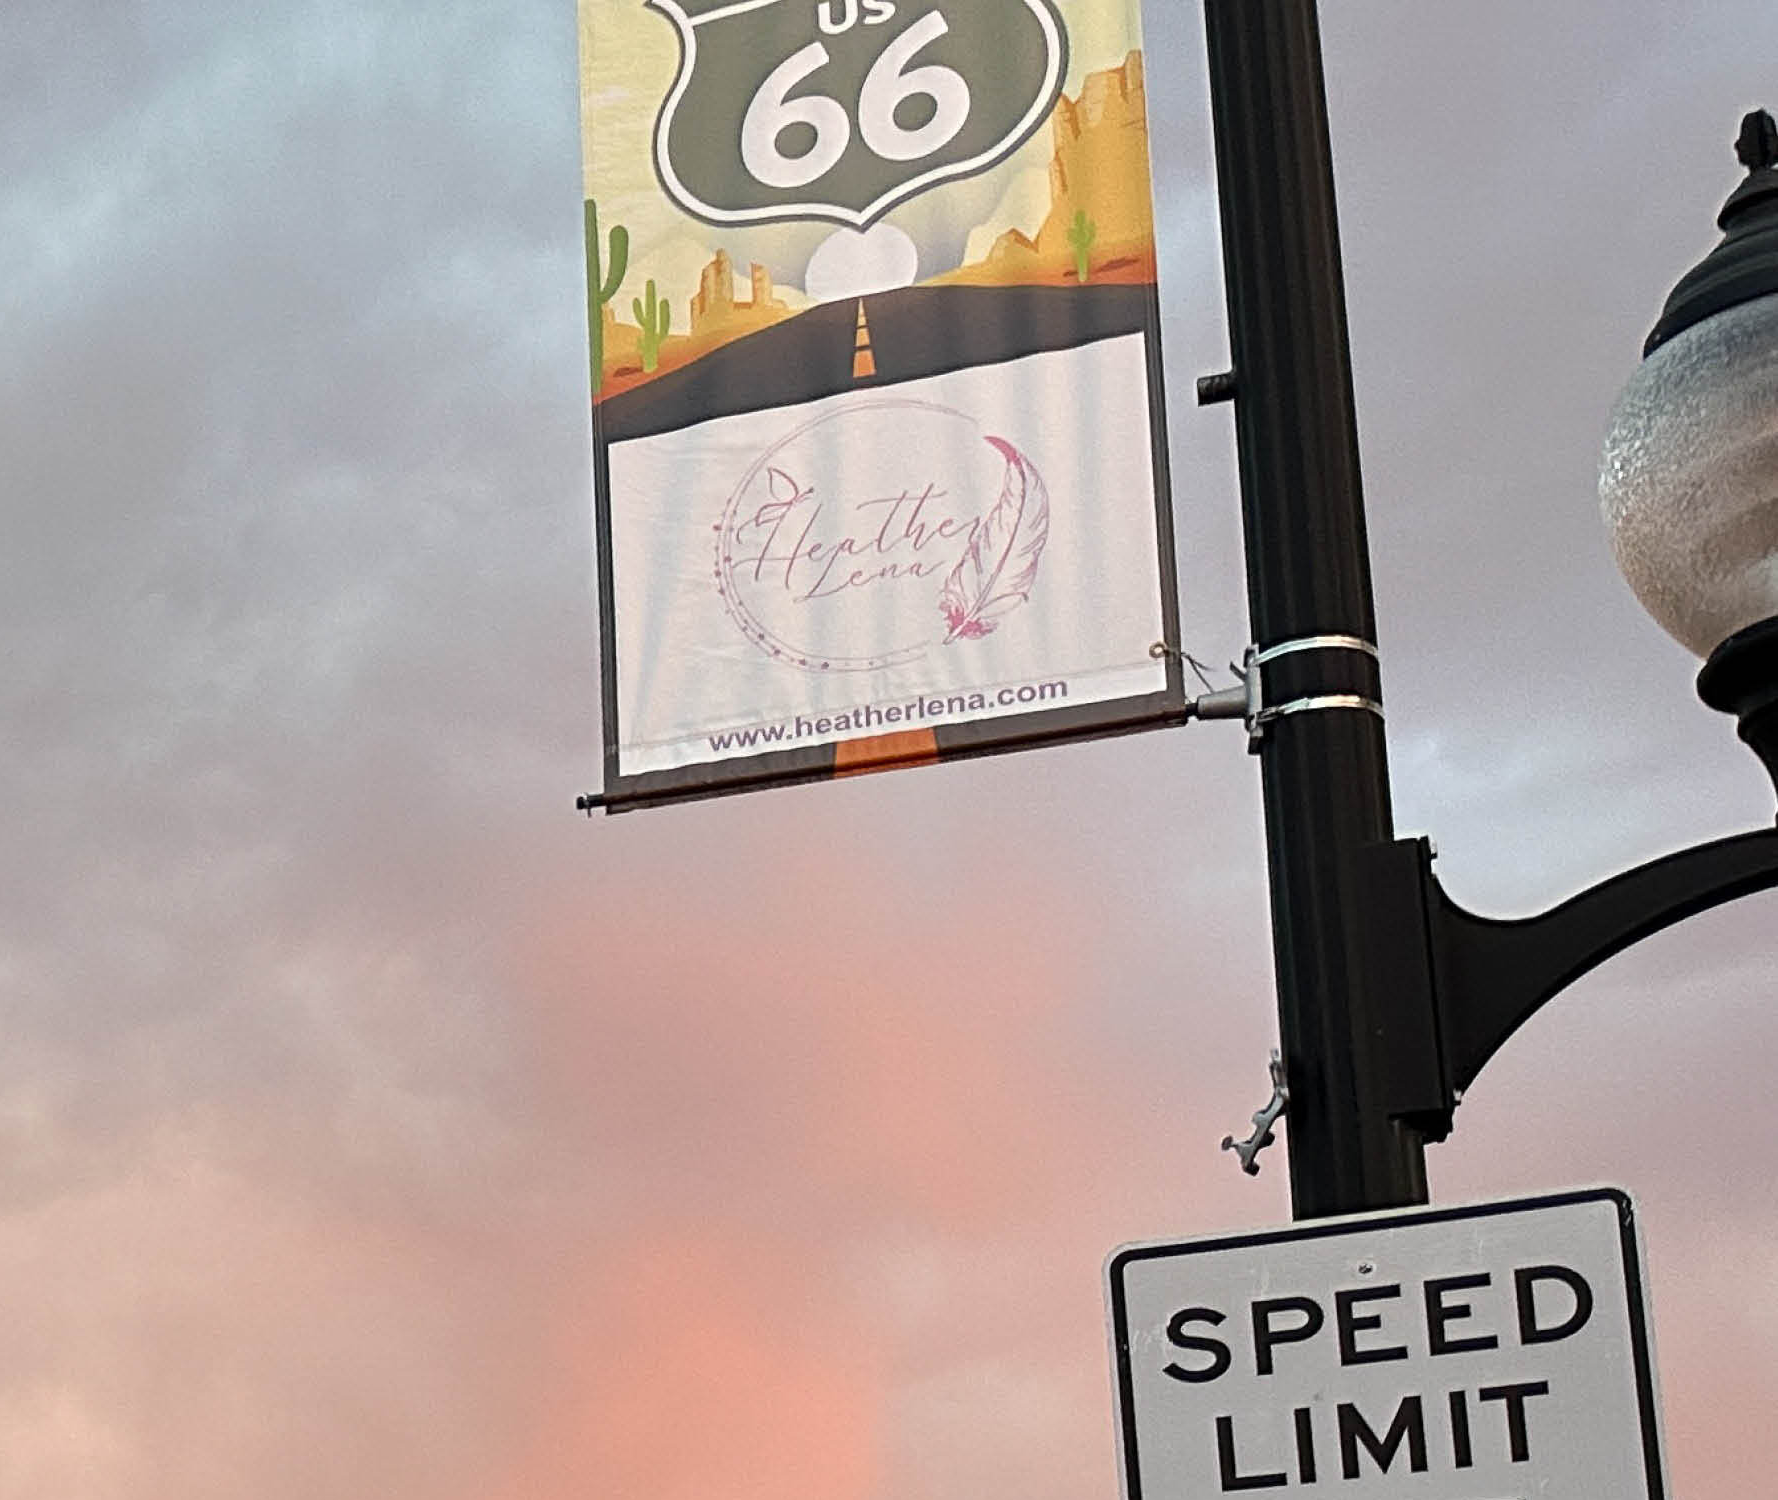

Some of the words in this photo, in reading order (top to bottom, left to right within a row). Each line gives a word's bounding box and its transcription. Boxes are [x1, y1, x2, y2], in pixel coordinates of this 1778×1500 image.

[740, 10, 970, 188] 66
[793, 544, 946, 603] Lena
[709, 680, 1069, 751] www.heatherlena.com
[1162, 1264, 1593, 1383] SPEED
[1216, 1380, 1549, 1492] LIMIT
